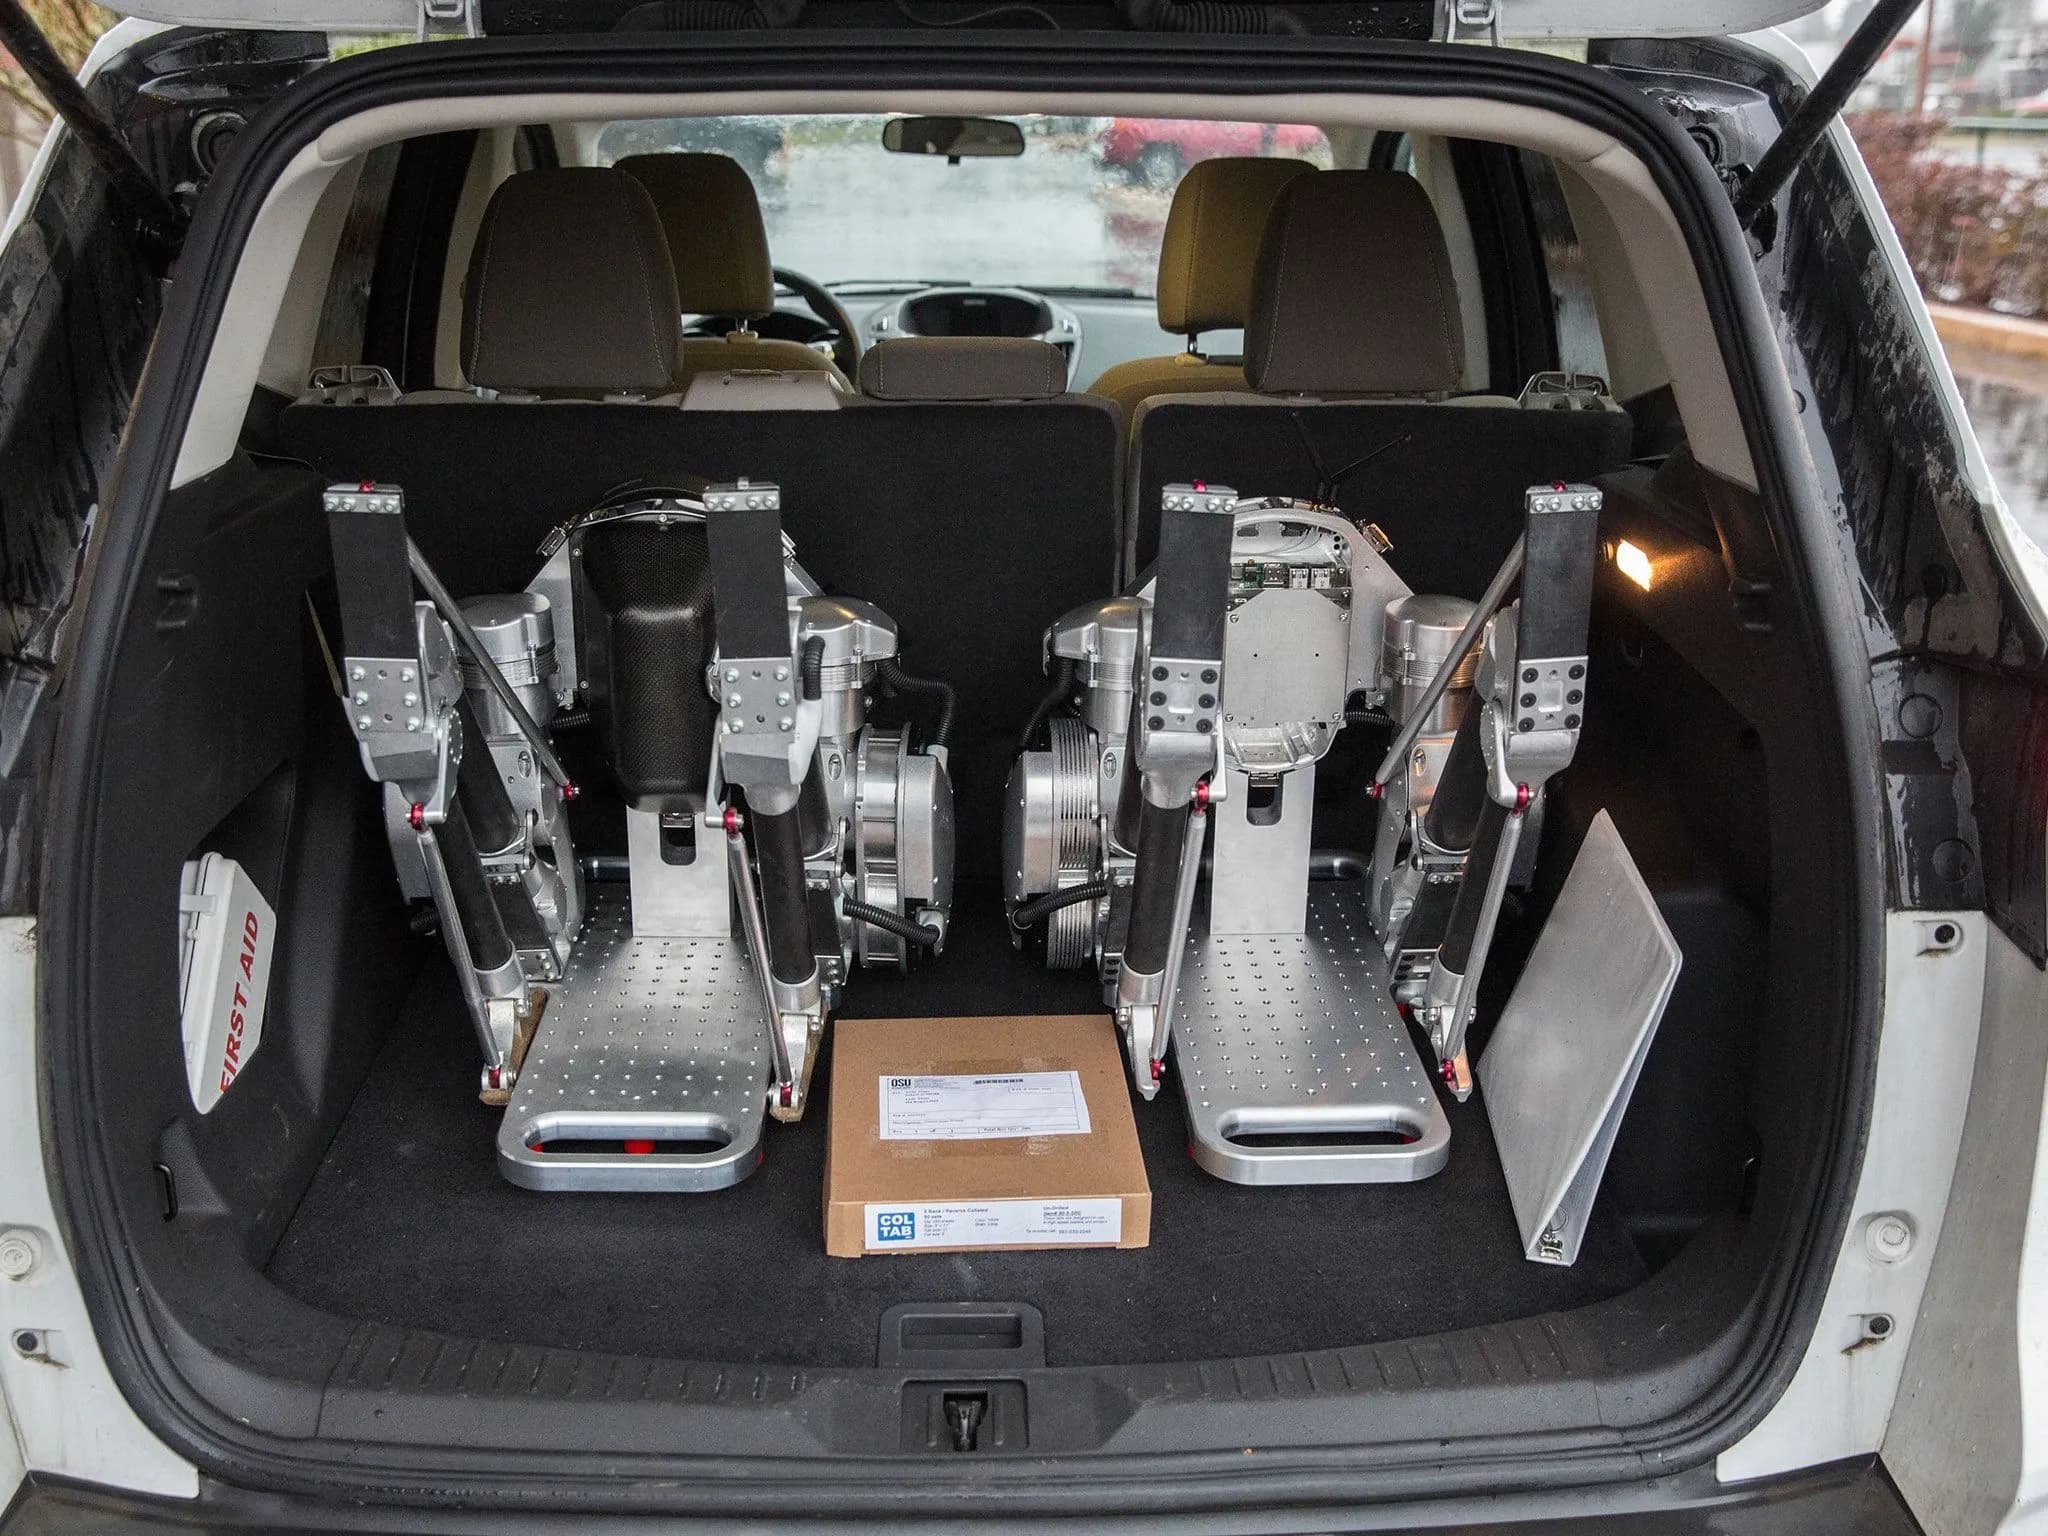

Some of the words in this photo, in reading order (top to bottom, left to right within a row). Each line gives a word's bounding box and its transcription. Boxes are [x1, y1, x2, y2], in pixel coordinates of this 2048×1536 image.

[219, 981, 248, 1094] FIRST
[239, 911, 258, 983] AID
[891, 1078, 912, 1087] OSU
[880, 1214, 913, 1226] COL
[879, 1225, 913, 1237] TAB
